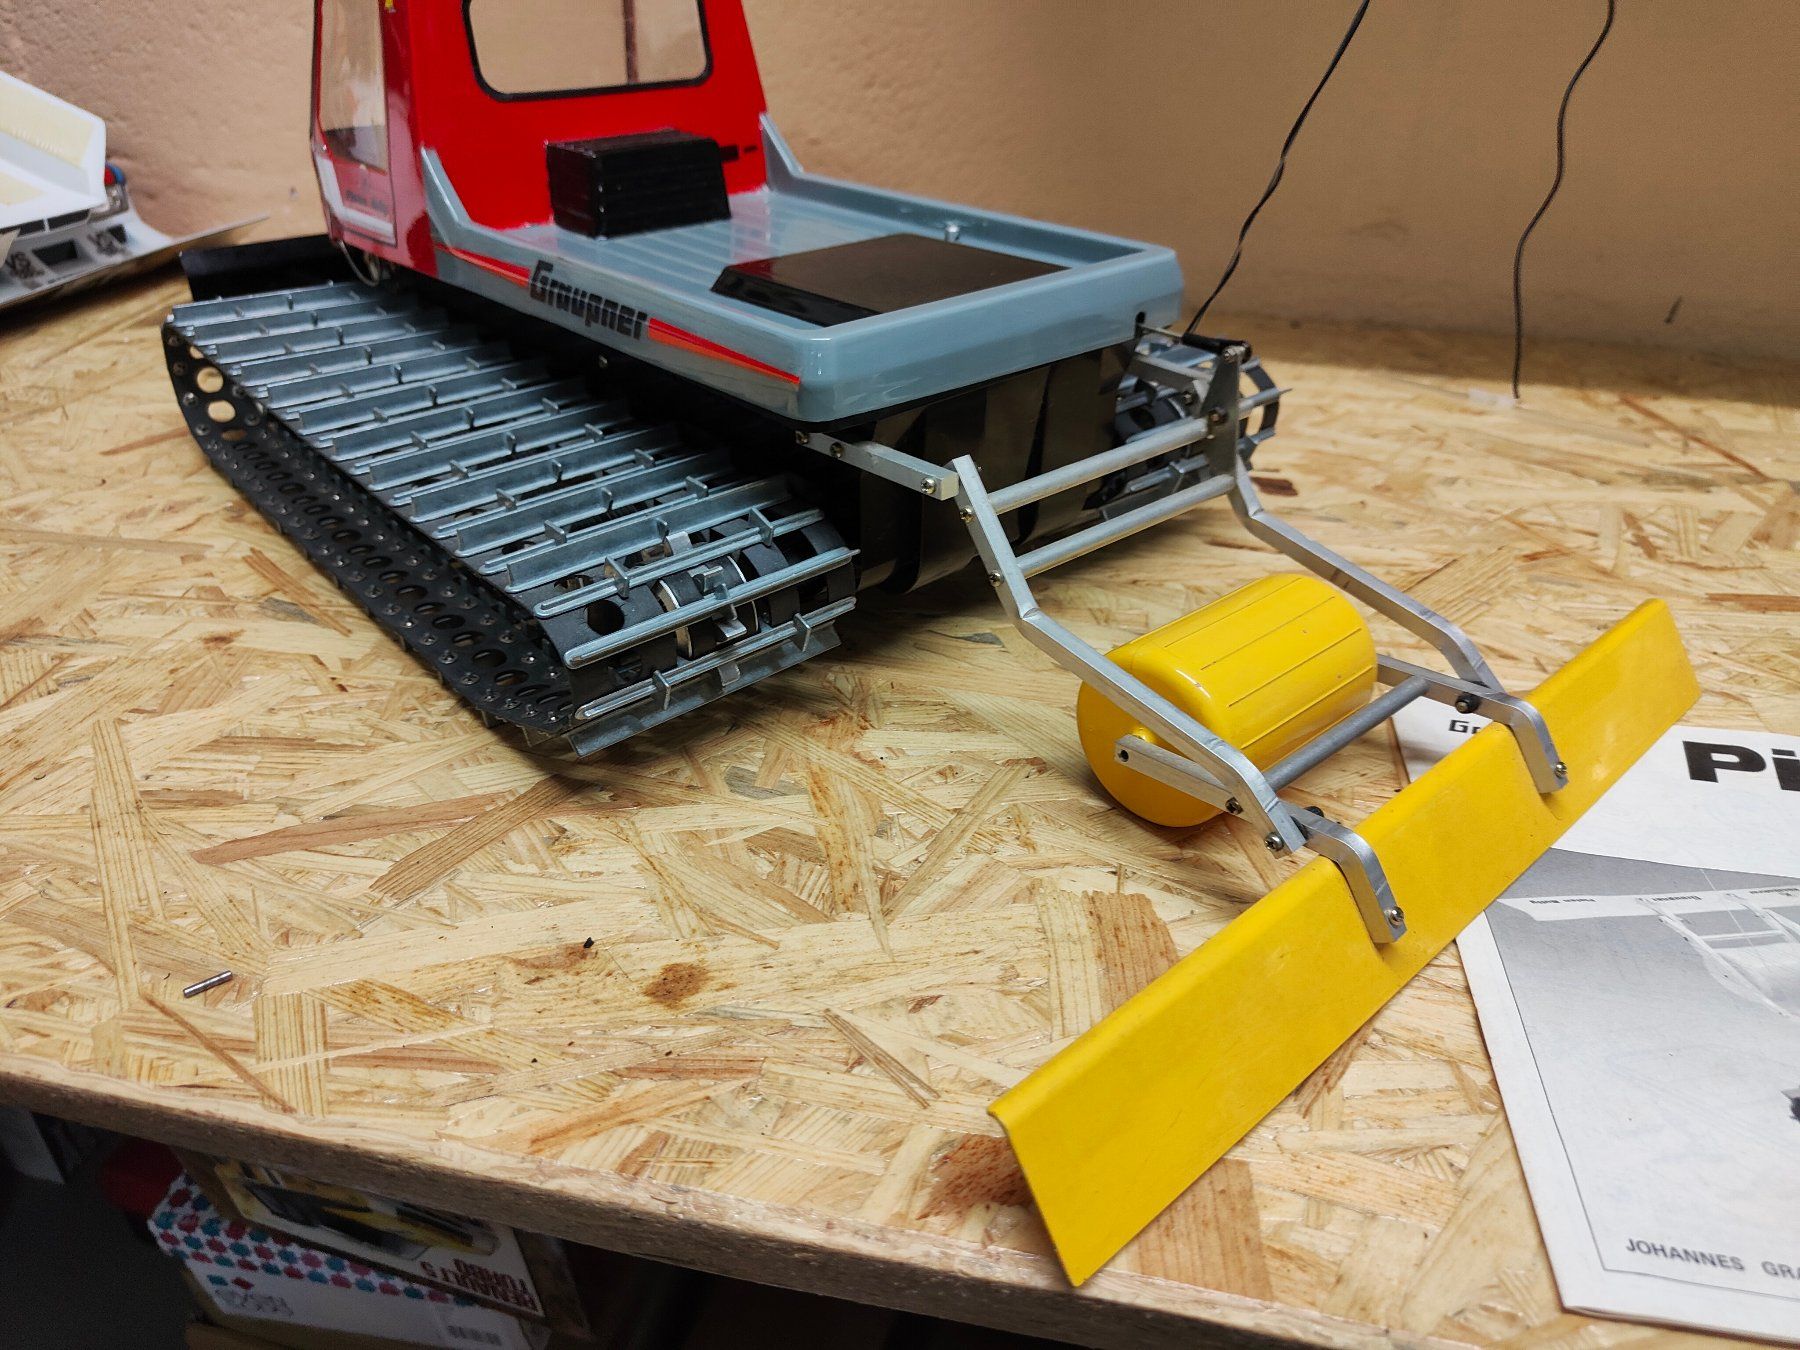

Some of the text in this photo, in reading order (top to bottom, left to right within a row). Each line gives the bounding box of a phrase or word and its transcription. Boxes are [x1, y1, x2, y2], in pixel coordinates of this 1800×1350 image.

[530, 260, 648, 340] Graupner
[1682, 740, 1800, 792] Pi
[1626, 1238, 1800, 1280] JOHANNES GR
